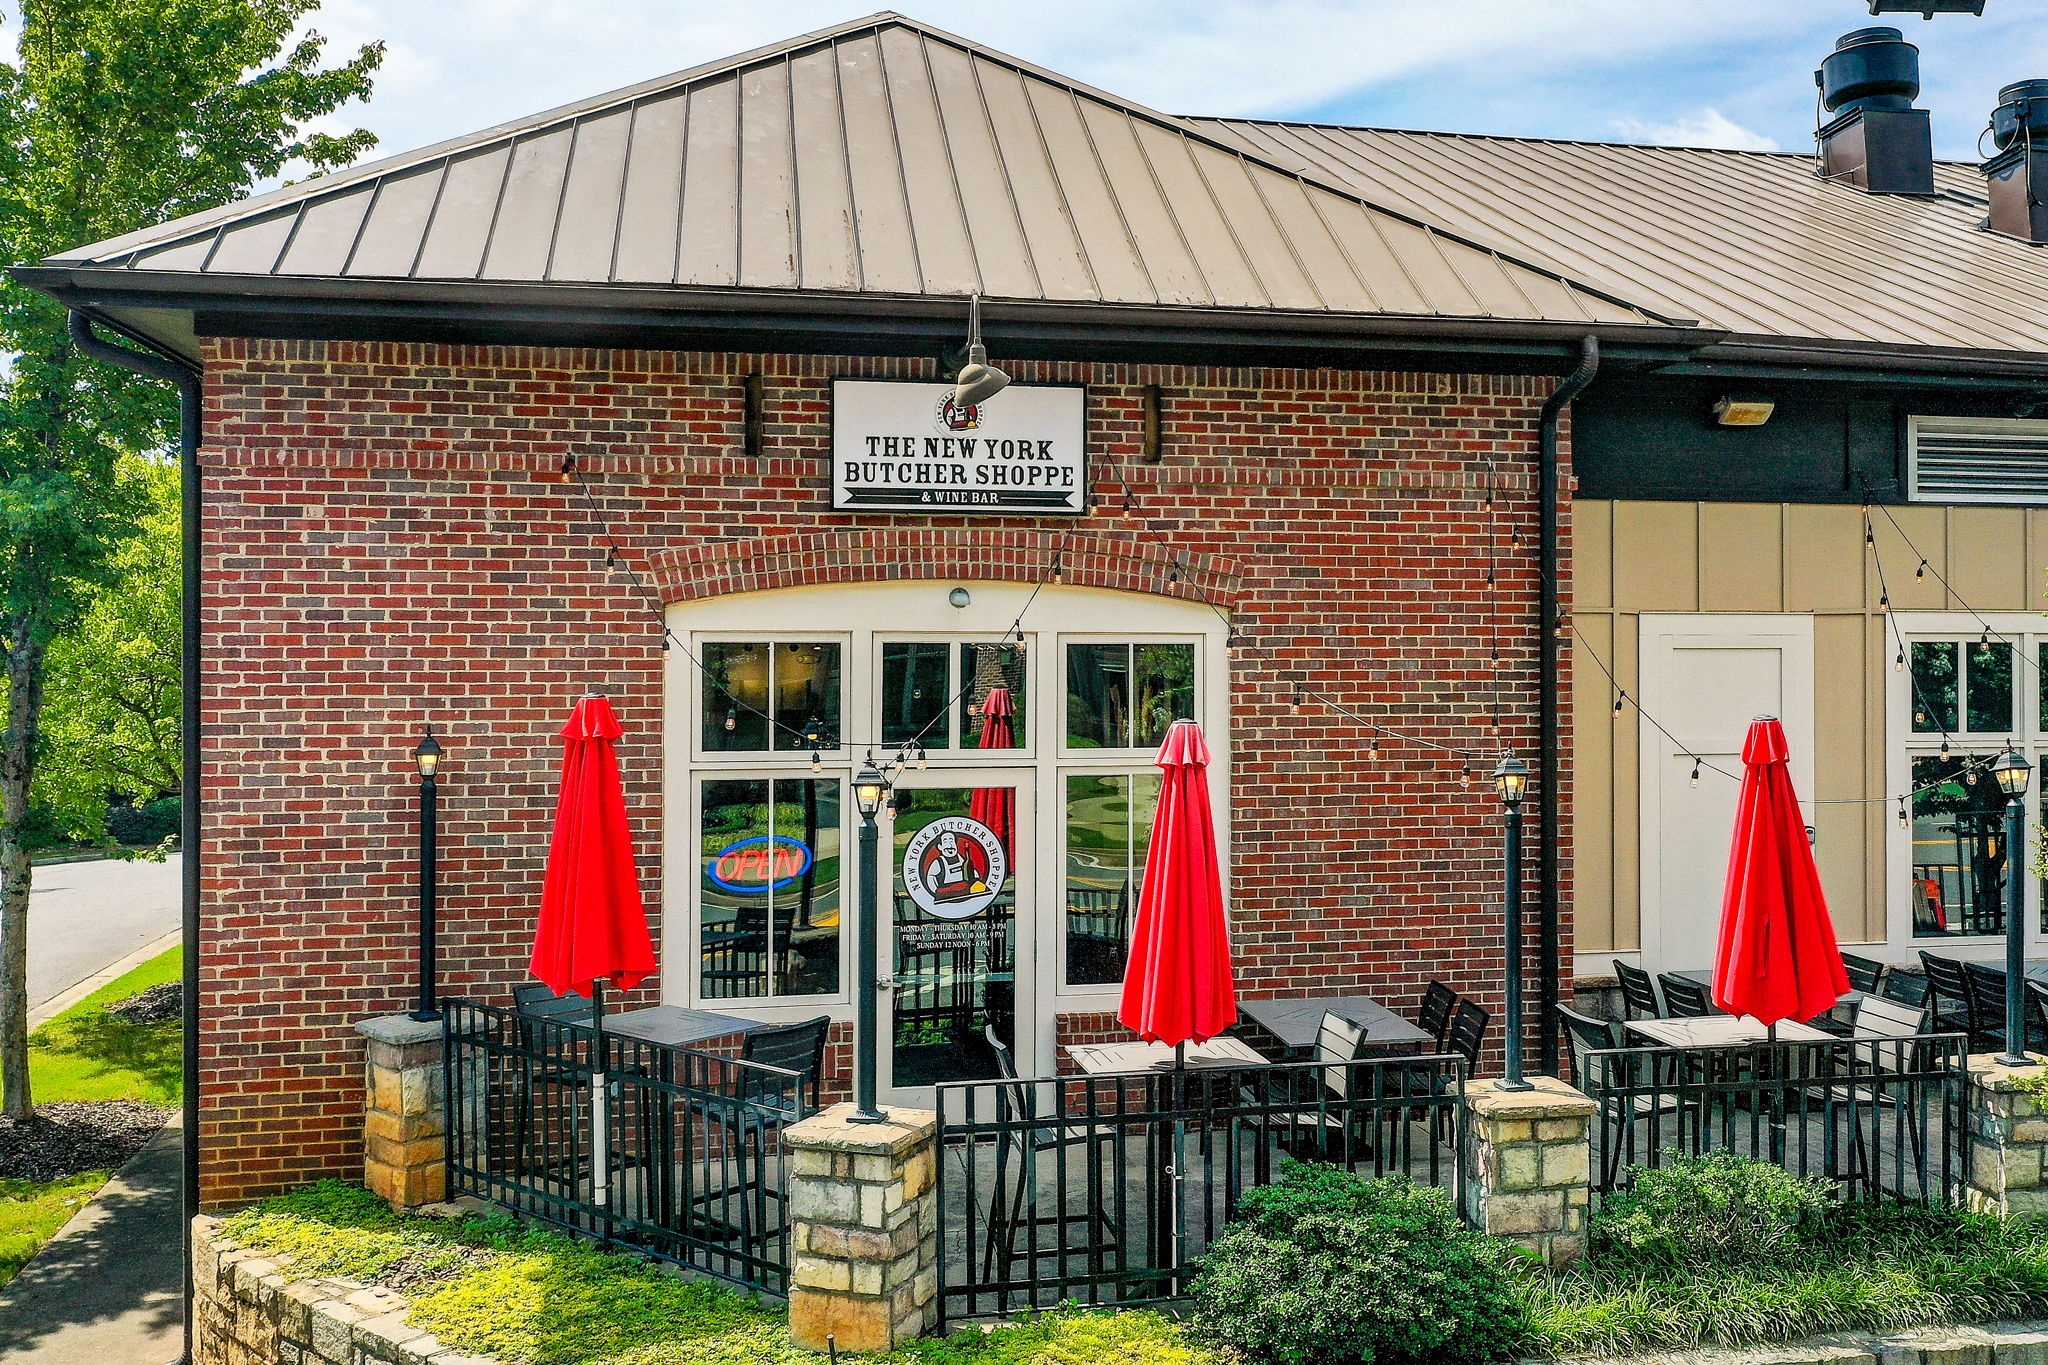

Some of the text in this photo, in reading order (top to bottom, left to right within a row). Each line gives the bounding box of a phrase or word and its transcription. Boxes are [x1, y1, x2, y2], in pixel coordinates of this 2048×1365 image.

[866, 436, 1054, 460] THE NEW YORK
[844, 462, 1074, 486] BUTCHER SHOPPE
[921, 492, 999, 504] & WINE BAR
[716, 848, 804, 882] OPEN
[907, 821, 1001, 892] NEW YORK BUTCHER SHOPPE
[932, 932, 966, 940] SATURDAY
[934, 924, 968, 932] THURSDAY
[916, 942, 944, 950] SUNDAY
